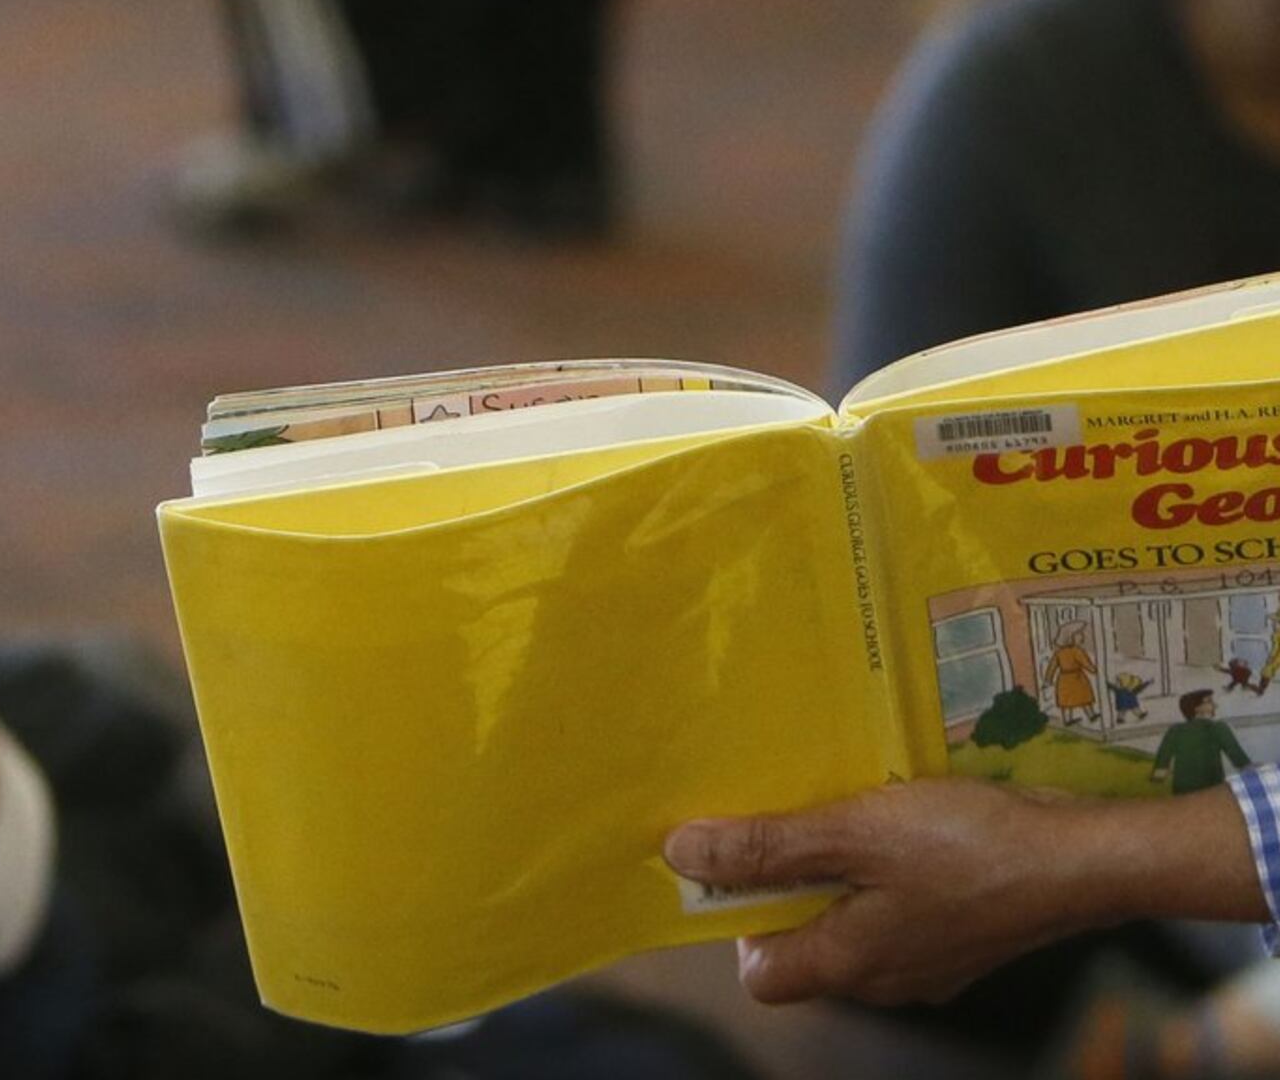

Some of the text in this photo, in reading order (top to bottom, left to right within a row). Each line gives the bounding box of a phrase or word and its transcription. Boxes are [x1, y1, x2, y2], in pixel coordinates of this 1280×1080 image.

[1087, 411, 1178, 428] MARGRET
[1184, 410, 1211, 422] and
[1028, 547, 1138, 574] GOES
[1147, 543, 1205, 567] TO
